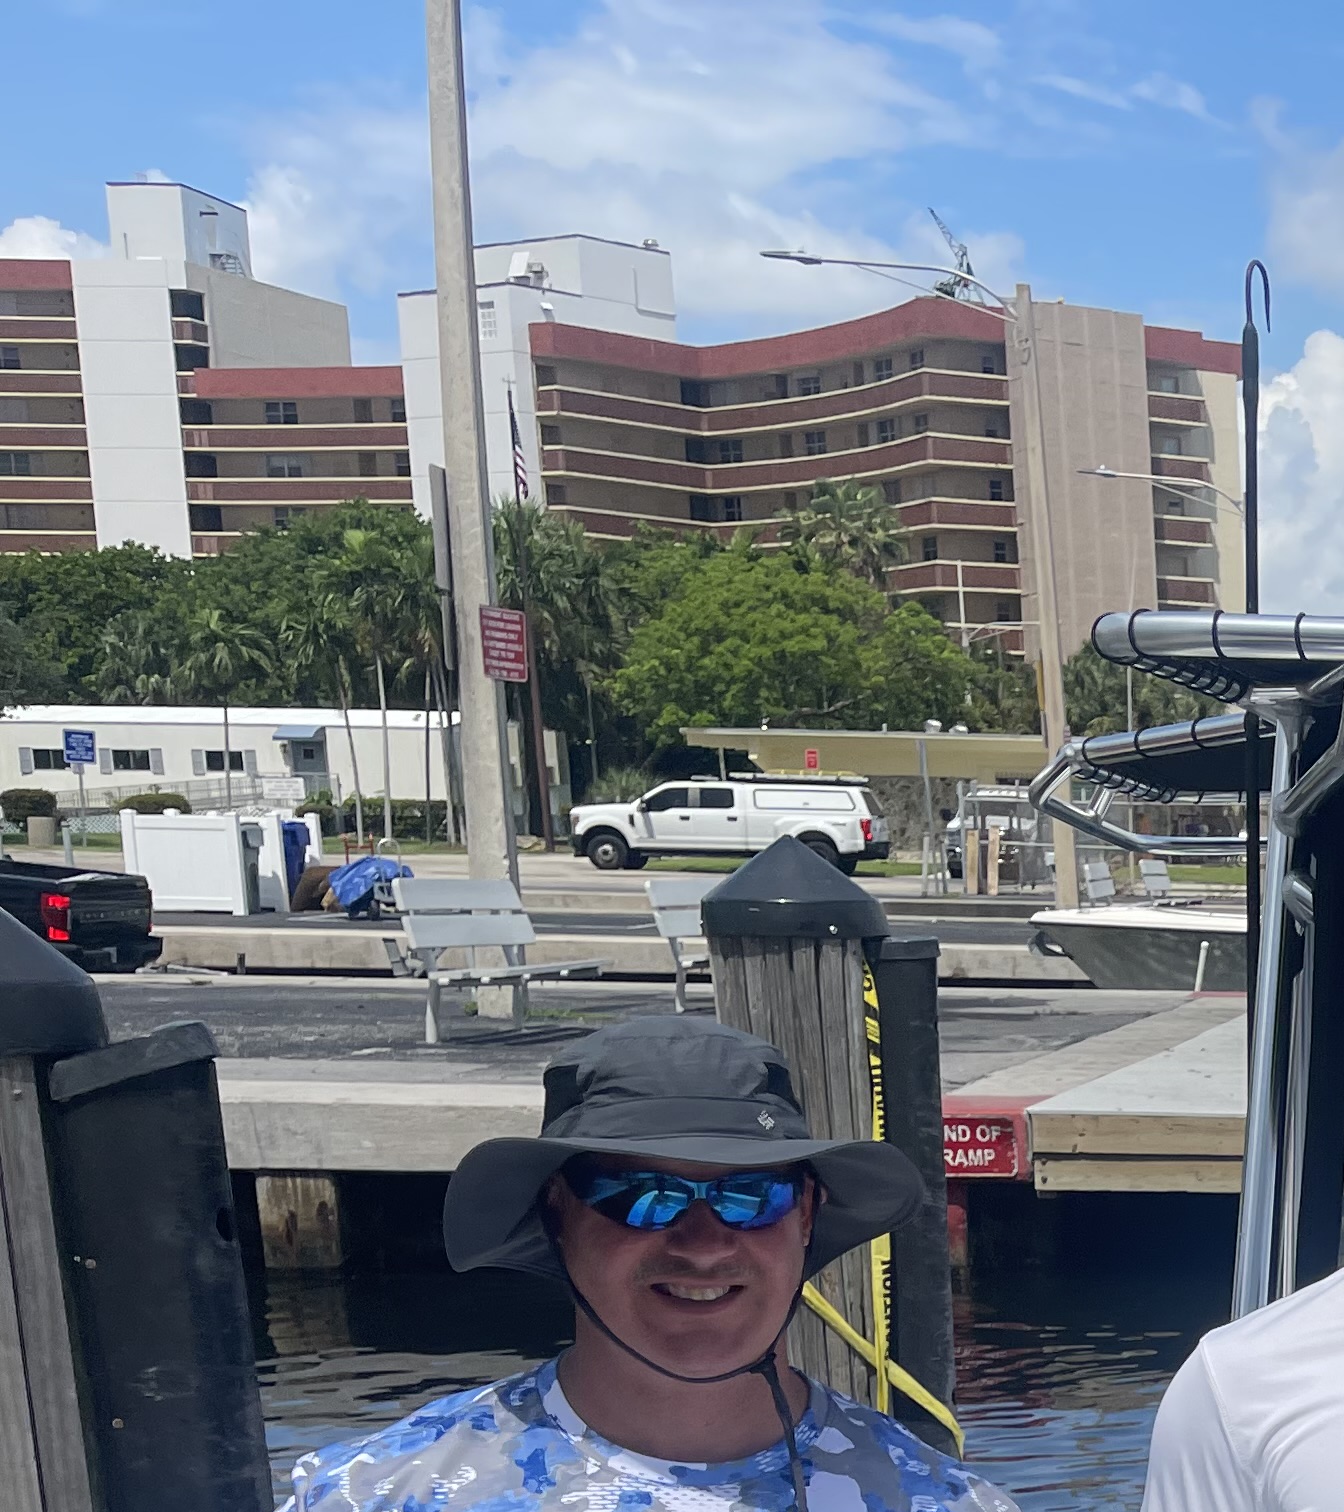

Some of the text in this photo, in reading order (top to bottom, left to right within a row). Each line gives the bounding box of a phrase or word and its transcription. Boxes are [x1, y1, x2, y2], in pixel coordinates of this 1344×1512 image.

[943, 1124, 1001, 1142] ND OF
[943, 1148, 996, 1168] RAMP
